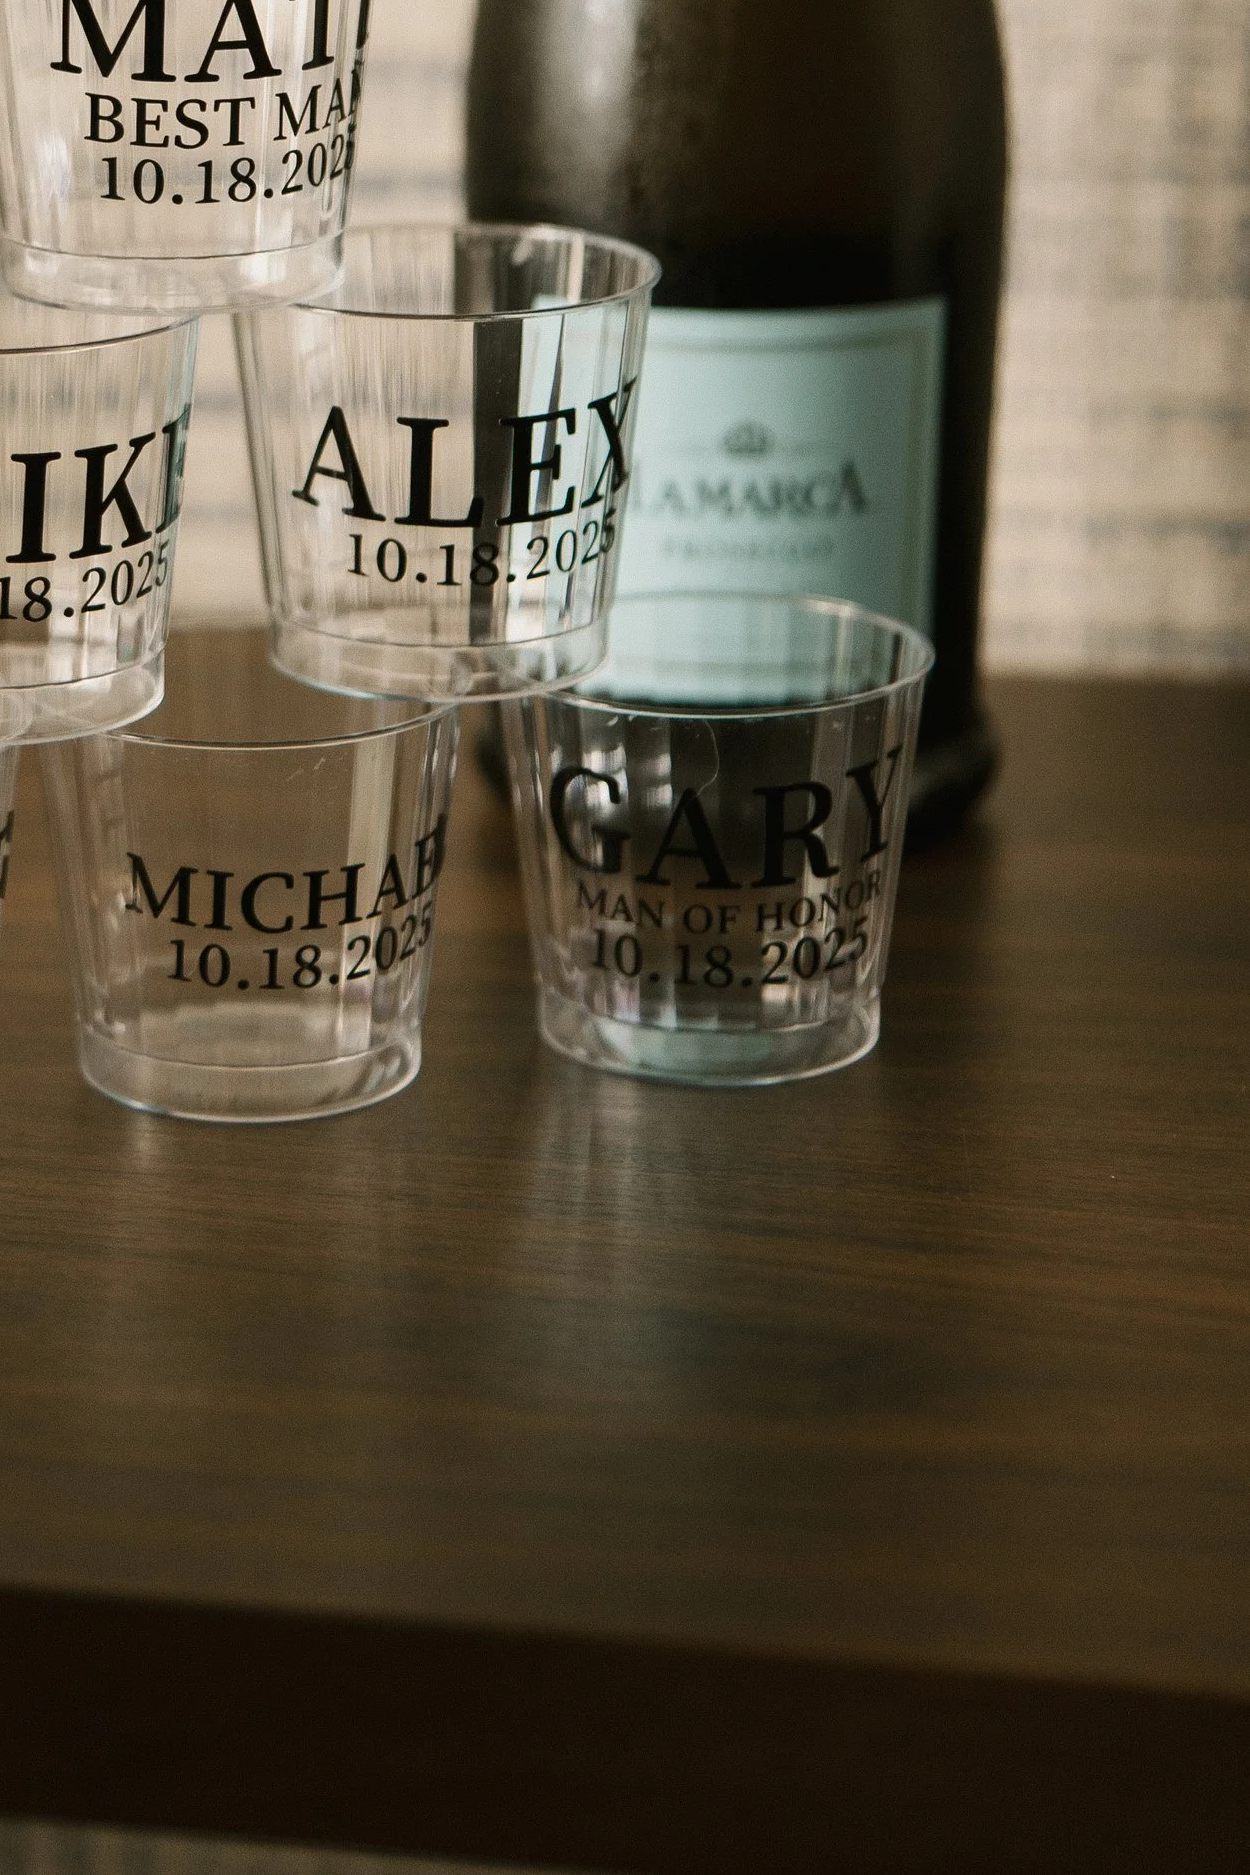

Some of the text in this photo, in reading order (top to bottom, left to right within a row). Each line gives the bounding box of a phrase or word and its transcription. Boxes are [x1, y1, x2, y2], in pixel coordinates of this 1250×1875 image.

[84, 92, 255, 149] BEST
[292, 376, 638, 528] ALEX
[348, 508, 617, 586] 10.18.2025
[551, 745, 903, 890] GARY
[576, 870, 881, 935] MAN OF HONOR
[167, 901, 433, 991] 10.18.2025
[592, 917, 868, 989] 10.18.2025
